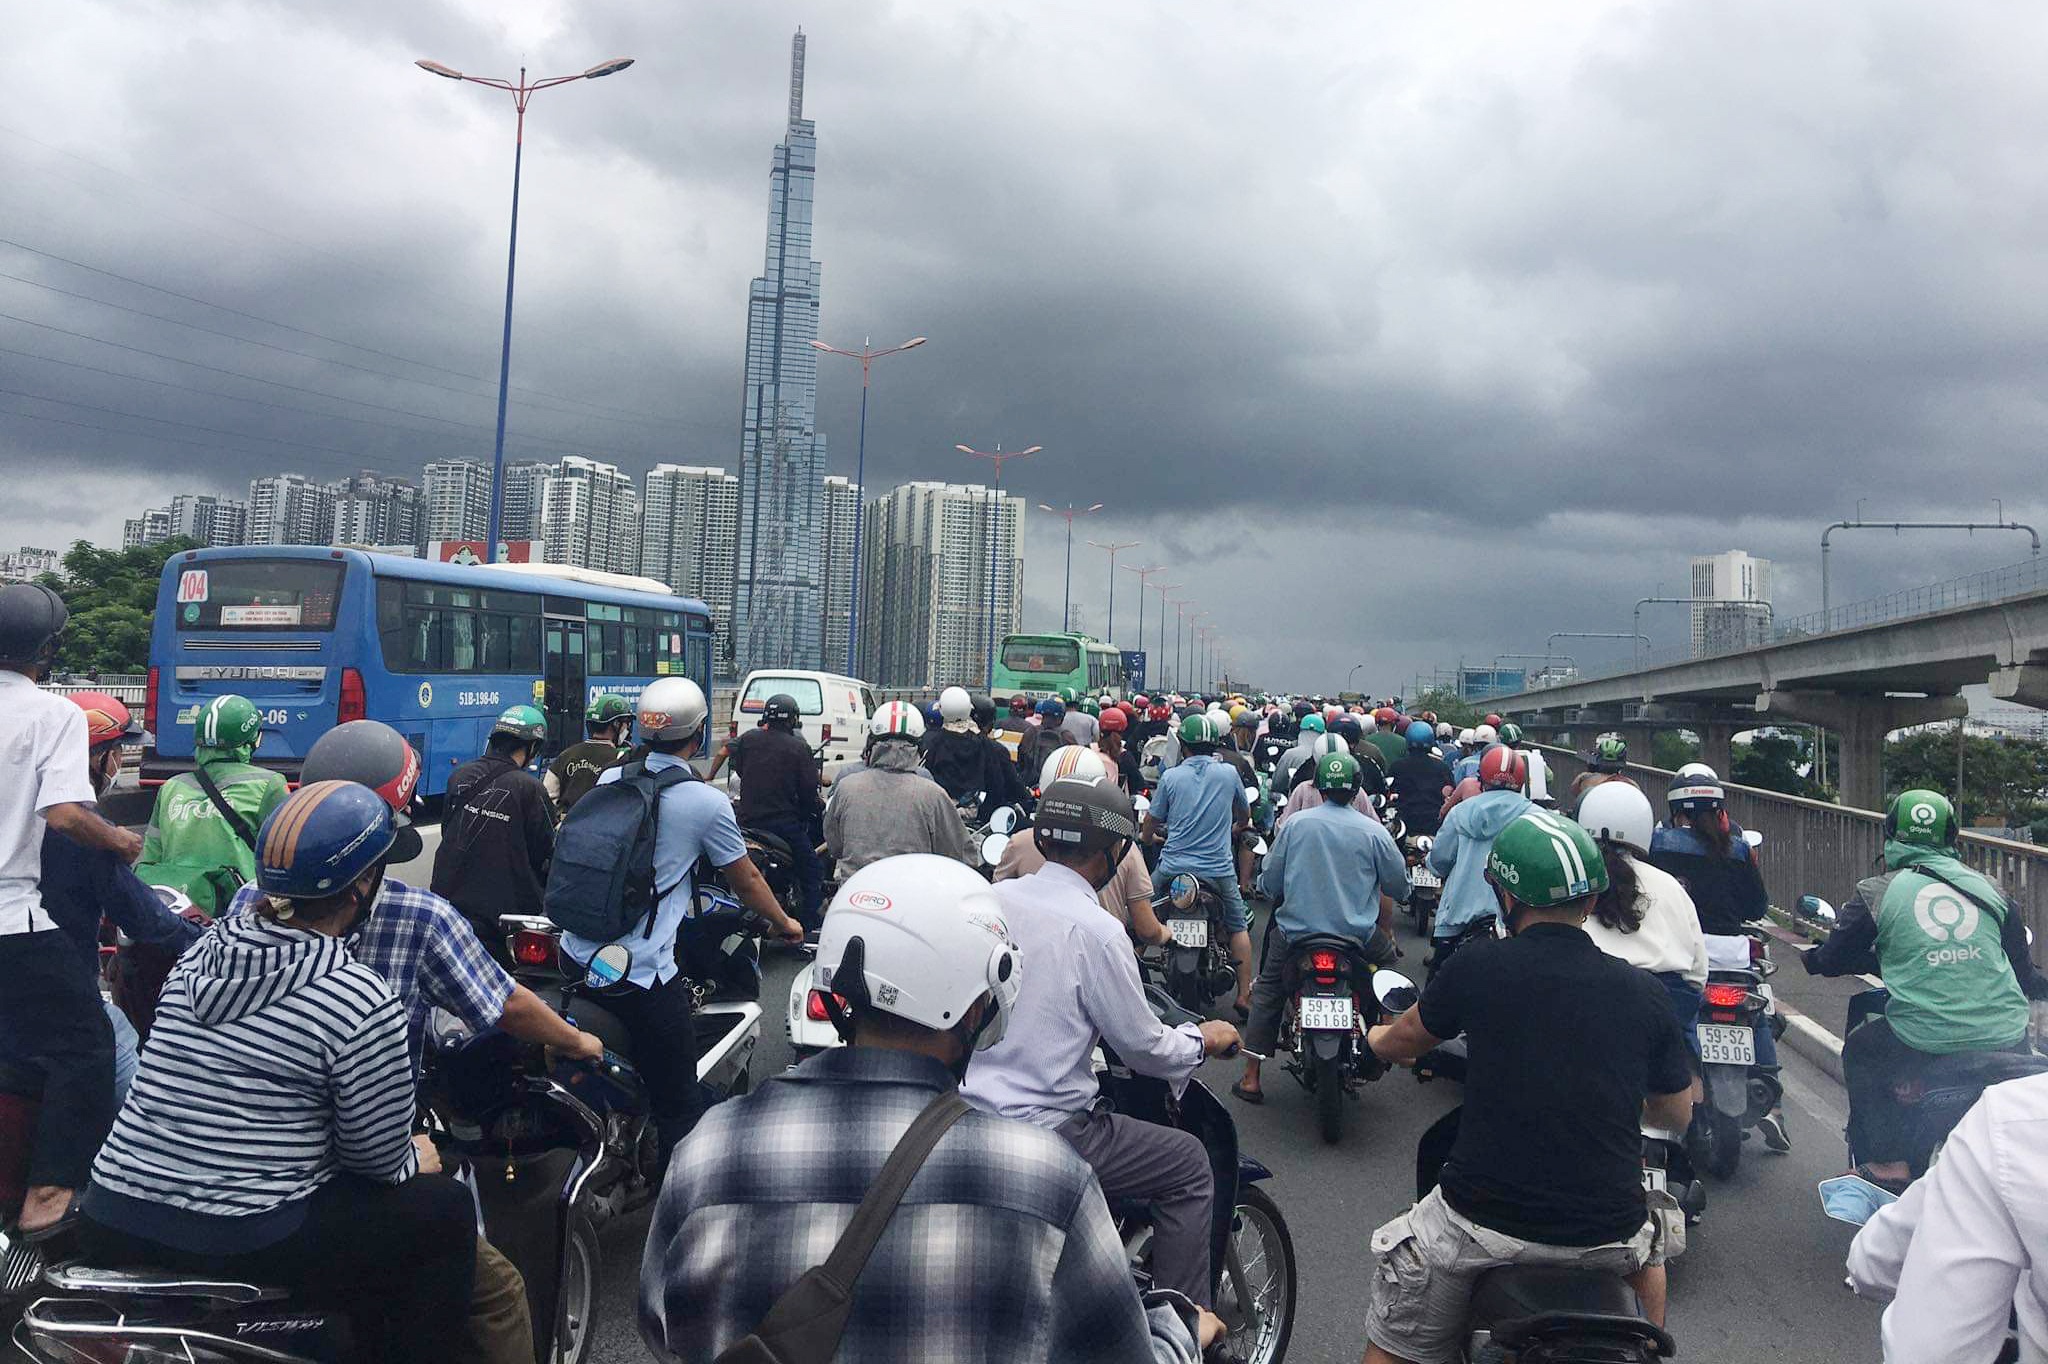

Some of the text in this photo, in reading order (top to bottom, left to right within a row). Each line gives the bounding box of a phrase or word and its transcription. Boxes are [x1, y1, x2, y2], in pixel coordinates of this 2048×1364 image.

[182, 573, 206, 600] 104
[459, 691, 500, 706] 51B-198-06
[240, 713, 258, 733] Grab
[481, 809, 511, 822] INSIDE
[1909, 825, 1933, 835] gojek
[1490, 852, 1520, 885] Grab
[1172, 921, 1200, 933] 59-F1
[1926, 944, 1984, 967] gojek
[1308, 999, 1345, 1013] 59-X3
[1304, 1013, 1349, 1028] 661.68
[1705, 1027, 1745, 1045] 59-S2
[1702, 1044, 1752, 1062] 359.06
